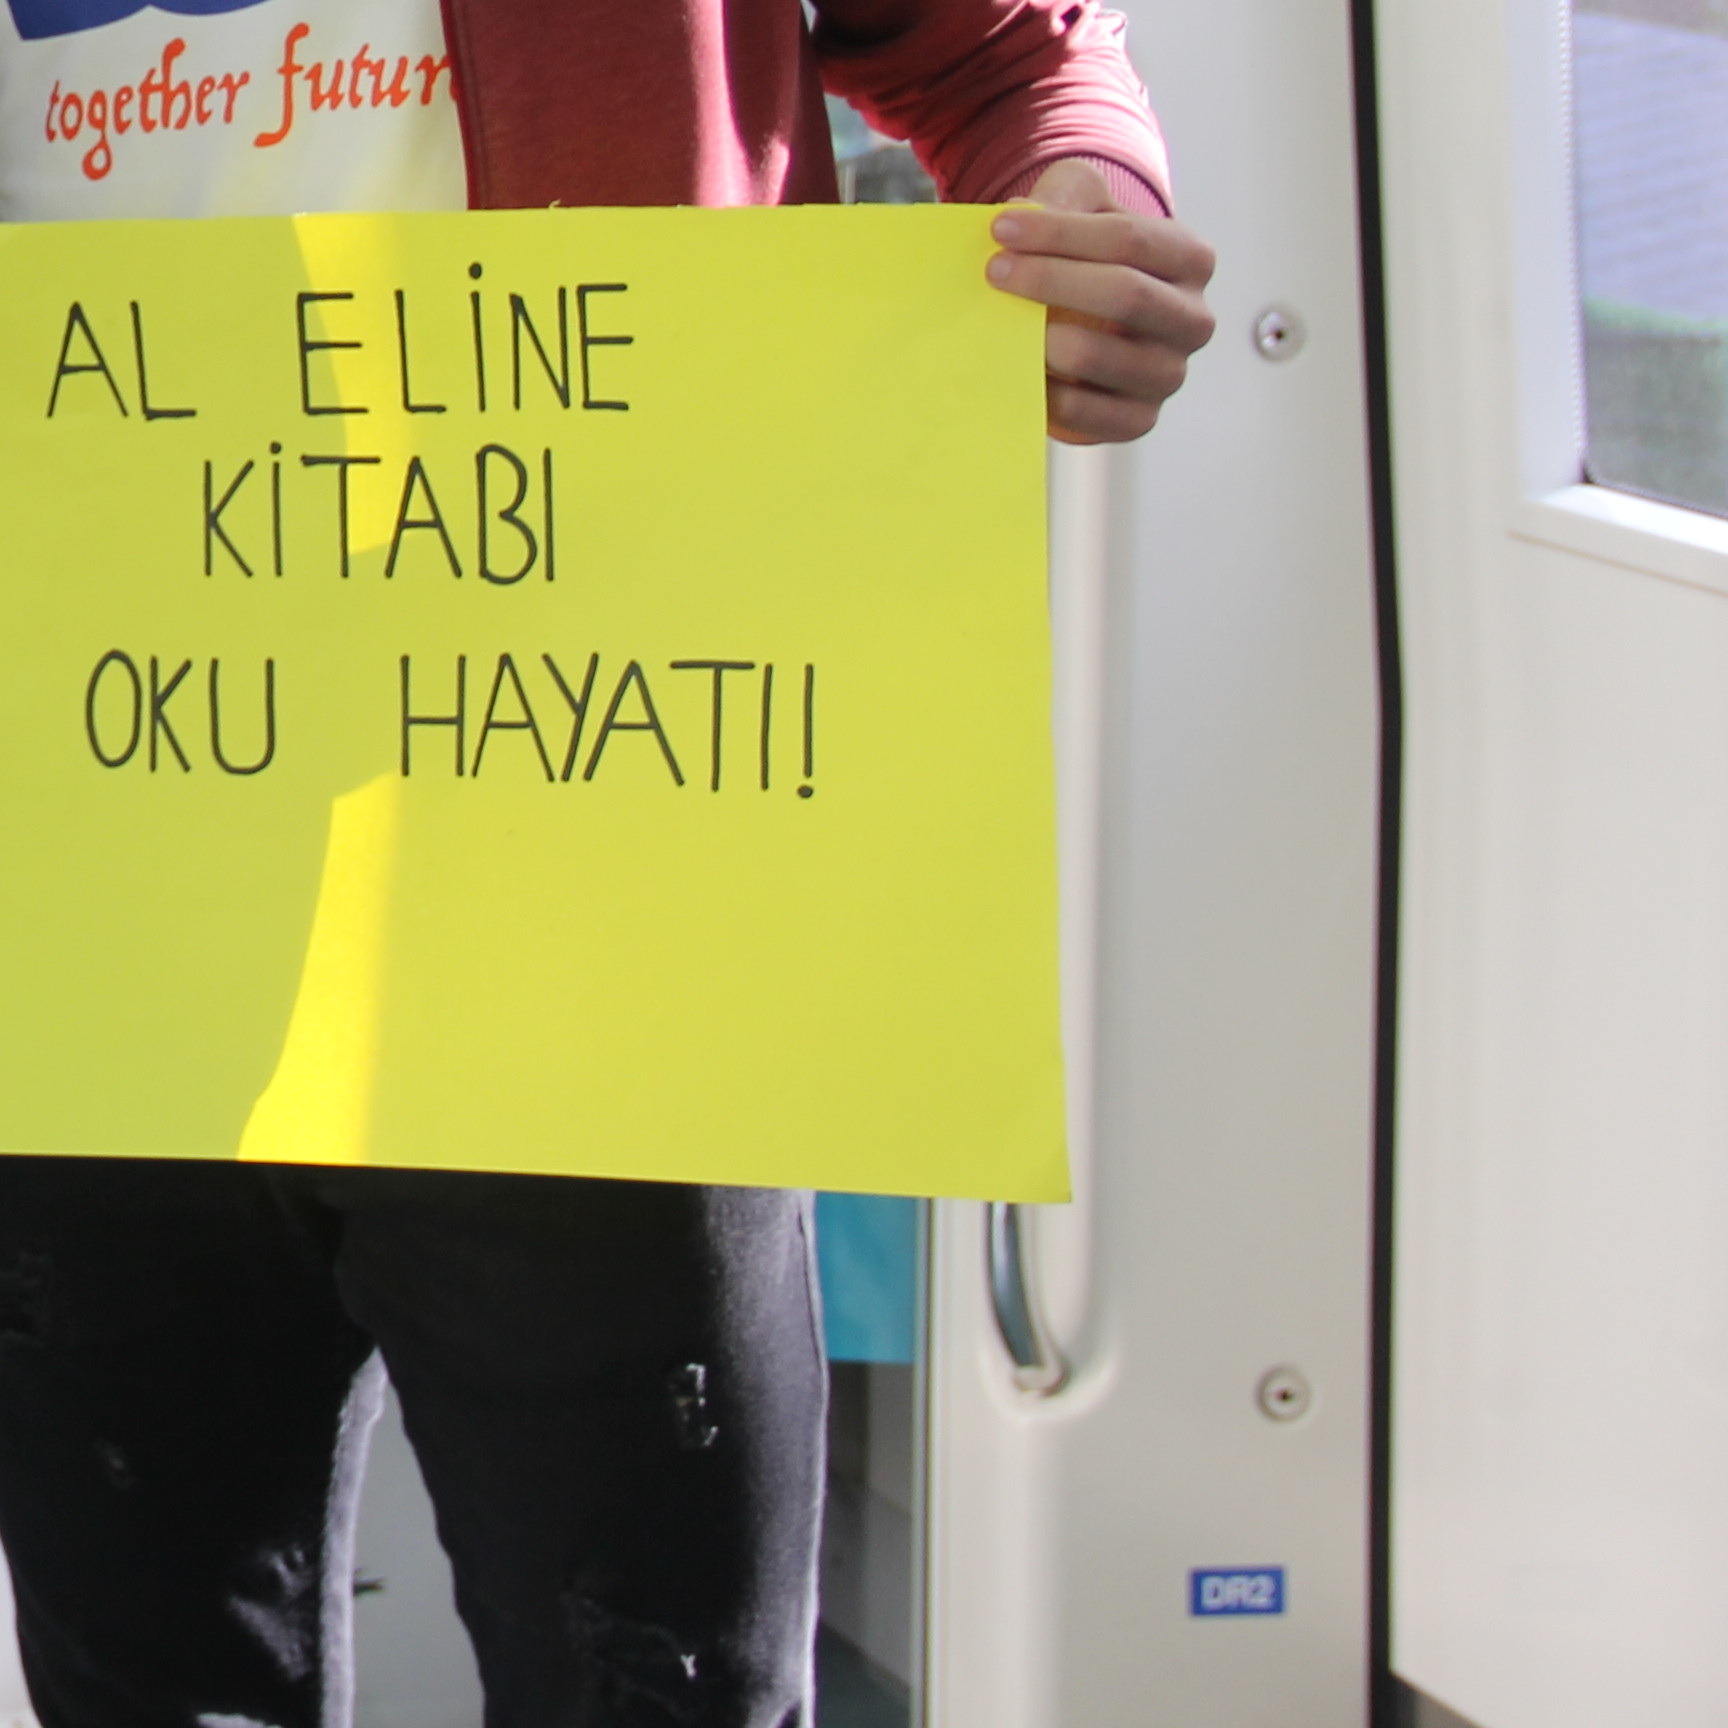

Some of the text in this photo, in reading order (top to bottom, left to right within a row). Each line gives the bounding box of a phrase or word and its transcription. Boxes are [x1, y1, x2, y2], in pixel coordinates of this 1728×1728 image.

[46, 22, 458, 181] together futur
[46, 262, 634, 422] AL ELİNE
[203, 441, 555, 586] KİTABI
[85, 649, 815, 799] OKU HAYATI!
